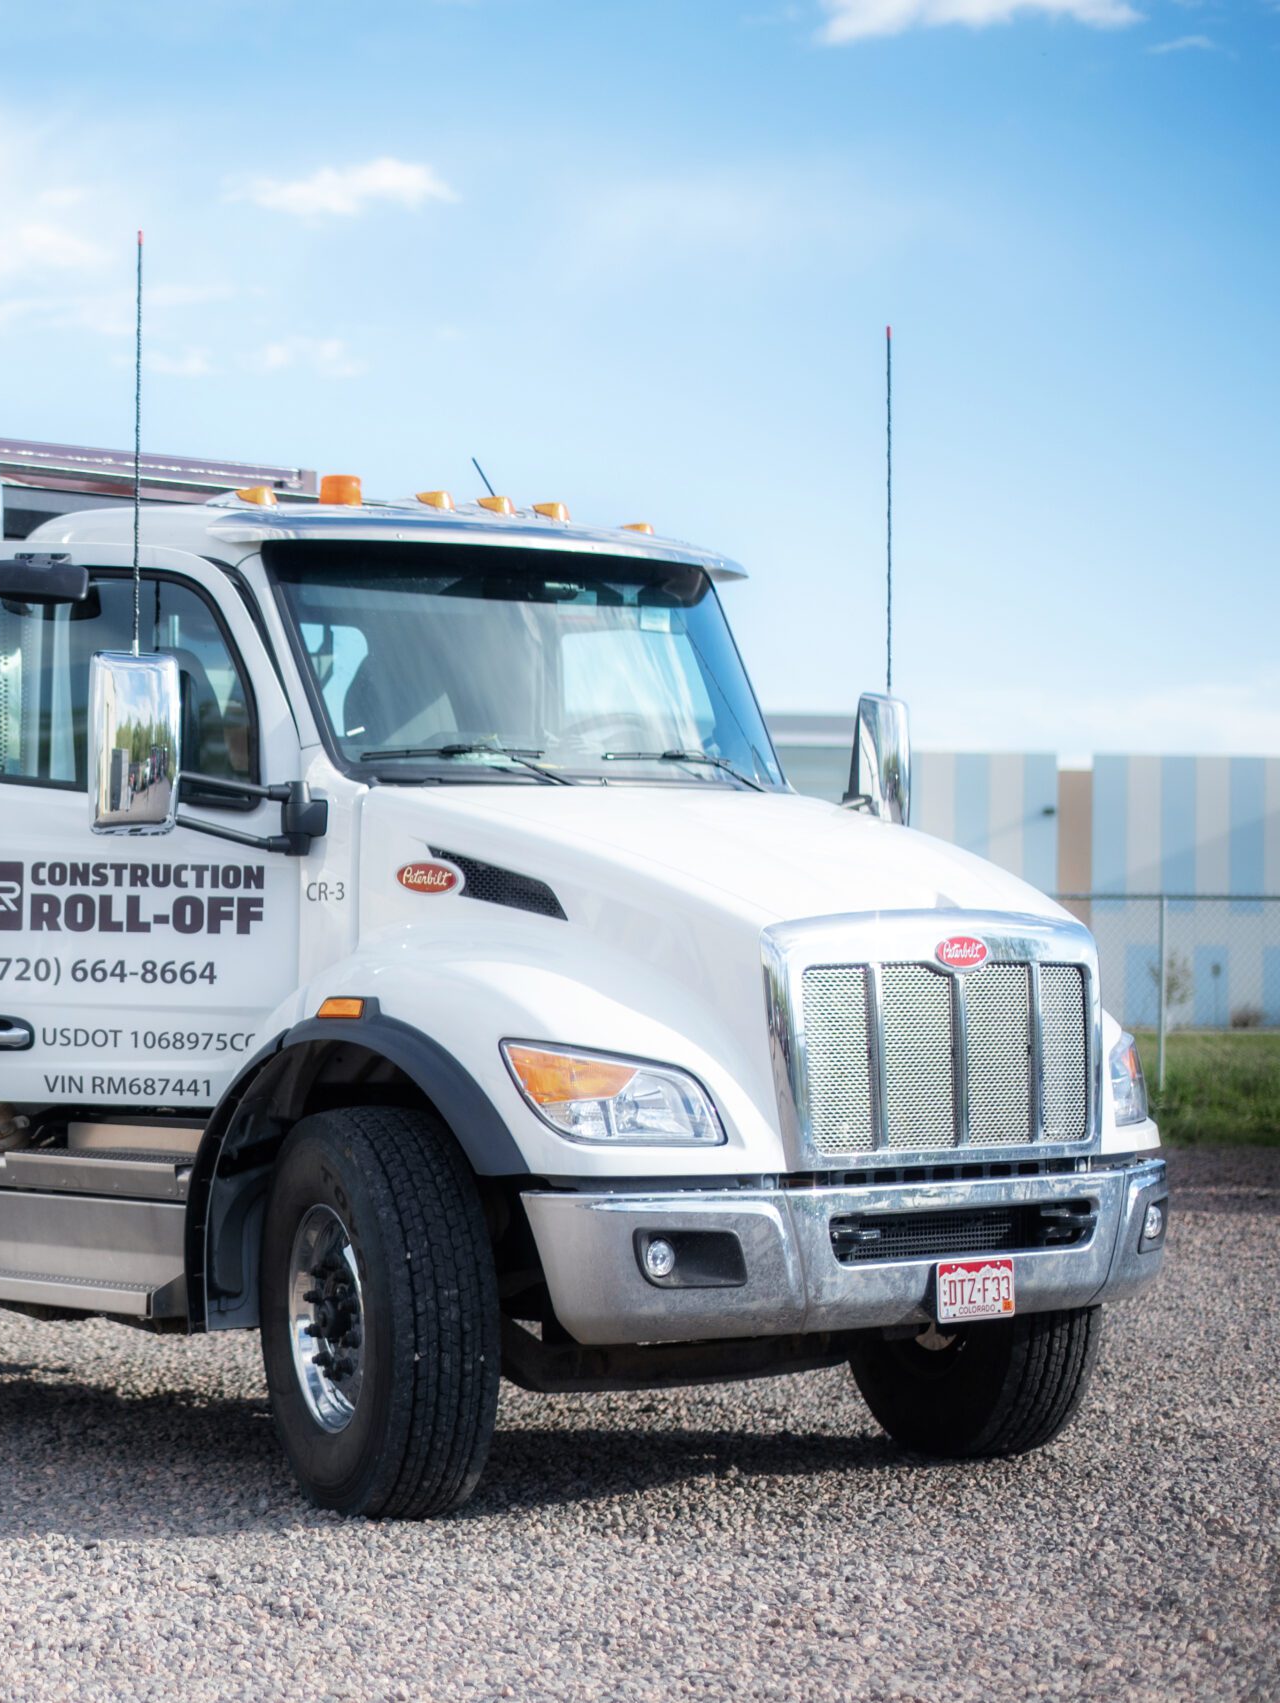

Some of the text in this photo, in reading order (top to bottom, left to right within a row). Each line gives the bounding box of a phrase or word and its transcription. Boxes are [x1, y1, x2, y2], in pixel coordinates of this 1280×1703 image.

[30, 860, 265, 890] CONSTRUCTION
[402, 865, 453, 887] Peterbilt
[305, 881, 346, 903] CR-3
[29, 893, 265, 935] ROLL-OFF
[942, 940, 983, 960] Peterbilt
[70, 958, 217, 986] 664-8664
[41, 1028, 123, 1049] USDOT
[43, 1074, 213, 1098] VIN RM687441
[958, 1303, 996, 1315] COLORADO
